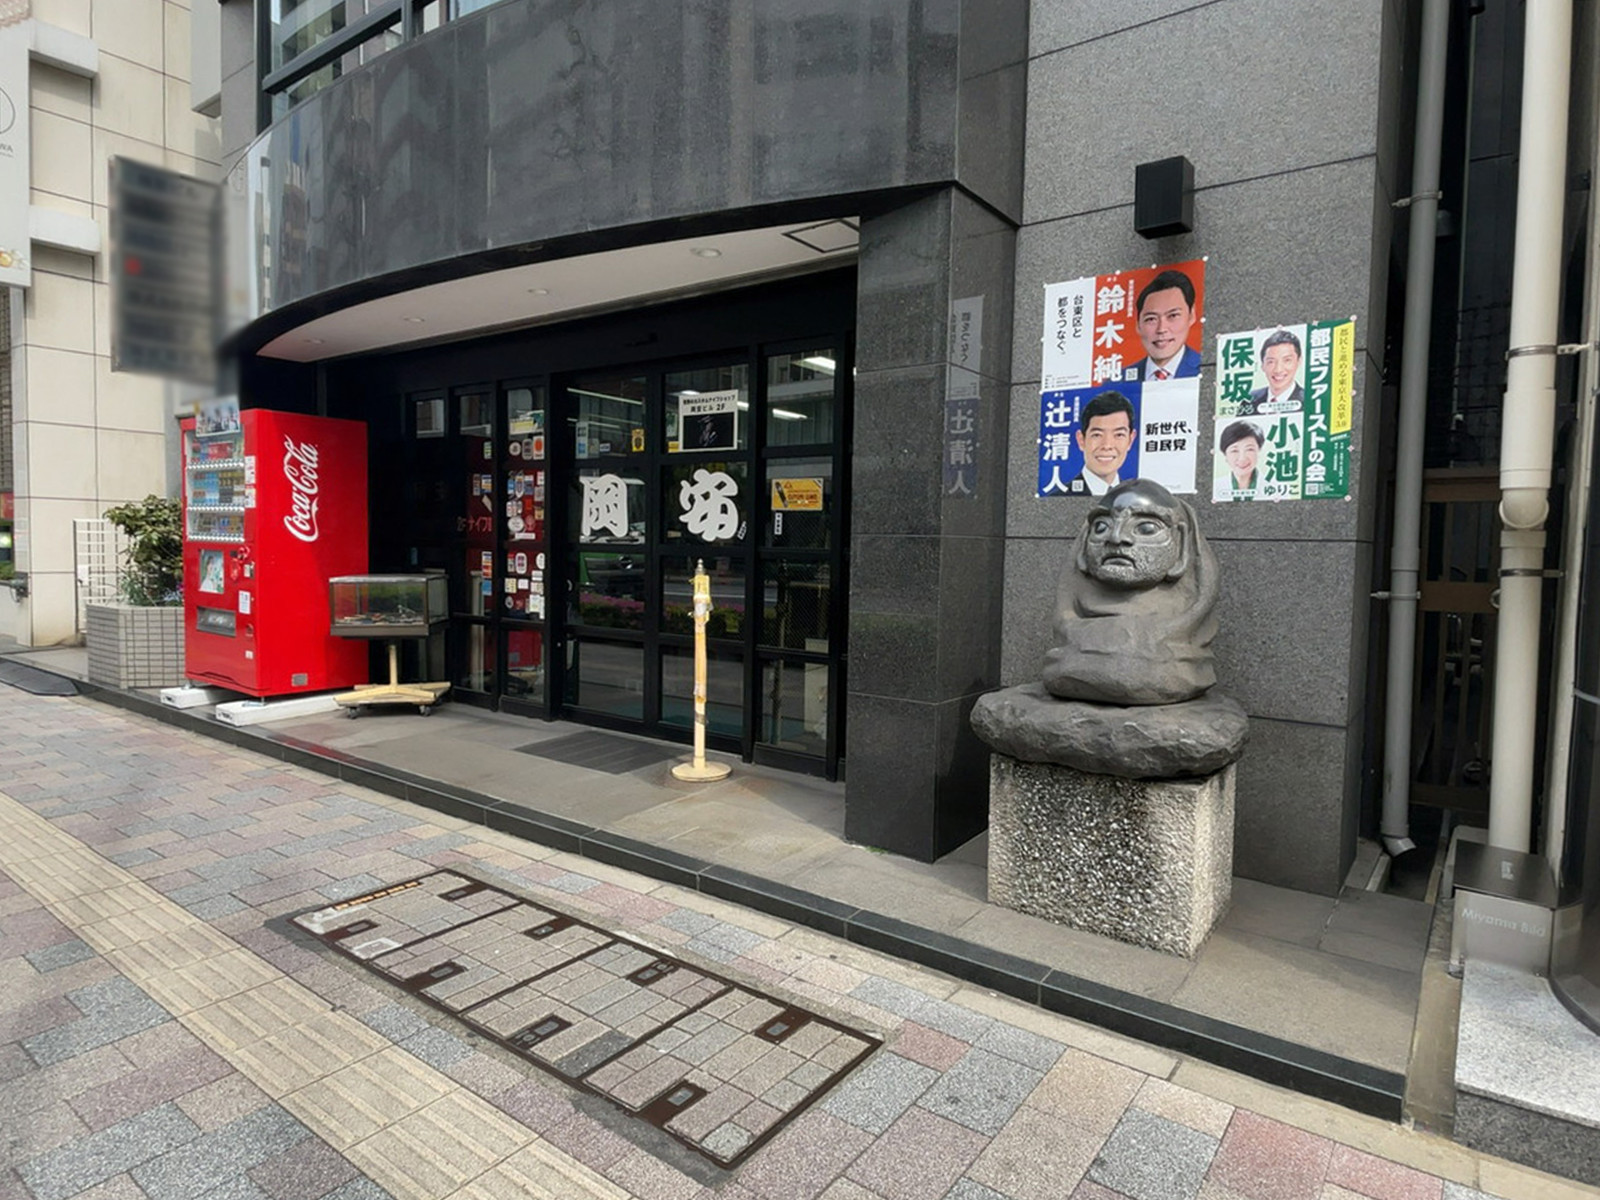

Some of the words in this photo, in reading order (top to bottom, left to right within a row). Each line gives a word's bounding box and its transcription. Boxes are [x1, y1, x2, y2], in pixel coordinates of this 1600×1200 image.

[1072, 294, 1084, 338] 台東区と
[1093, 284, 1126, 384] 鈴木純
[1221, 337, 1255, 403] 保坂
[1145, 421, 1193, 436] 新世代、
[1305, 327, 1332, 482] 都民ファーストの会
[1042, 400, 1072, 493] 辻清人
[1145, 439, 1187, 452] 自民党
[1264, 417, 1301, 482] 小池
[283, 434, 319, 542] Coca-Cola
[1264, 484, 1299, 496] ゆりこ
[1461, 908, 1518, 930] Miyama
